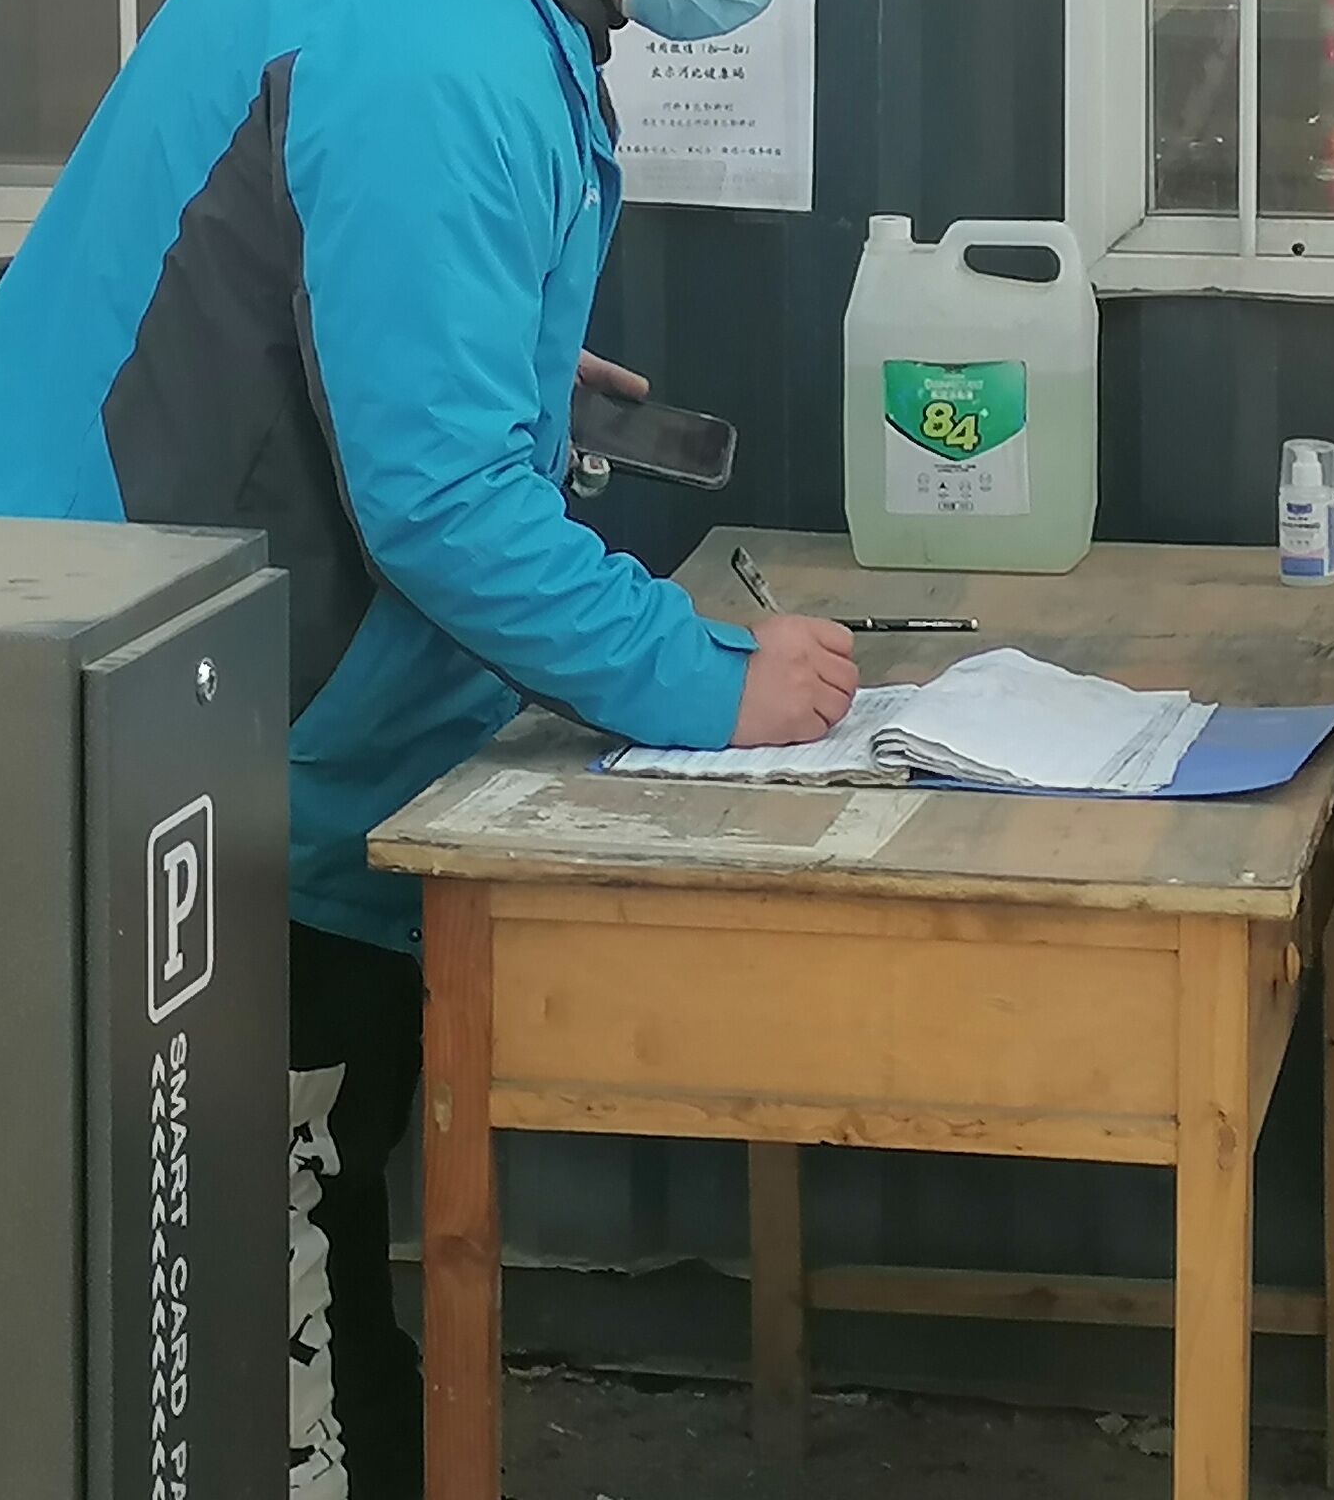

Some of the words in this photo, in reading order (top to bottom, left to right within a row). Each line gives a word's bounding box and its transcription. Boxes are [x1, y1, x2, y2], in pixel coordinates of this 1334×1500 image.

[920, 399, 982, 452] 84
[169, 1031, 189, 1227] SMART
[169, 1256, 188, 1417] CARD
